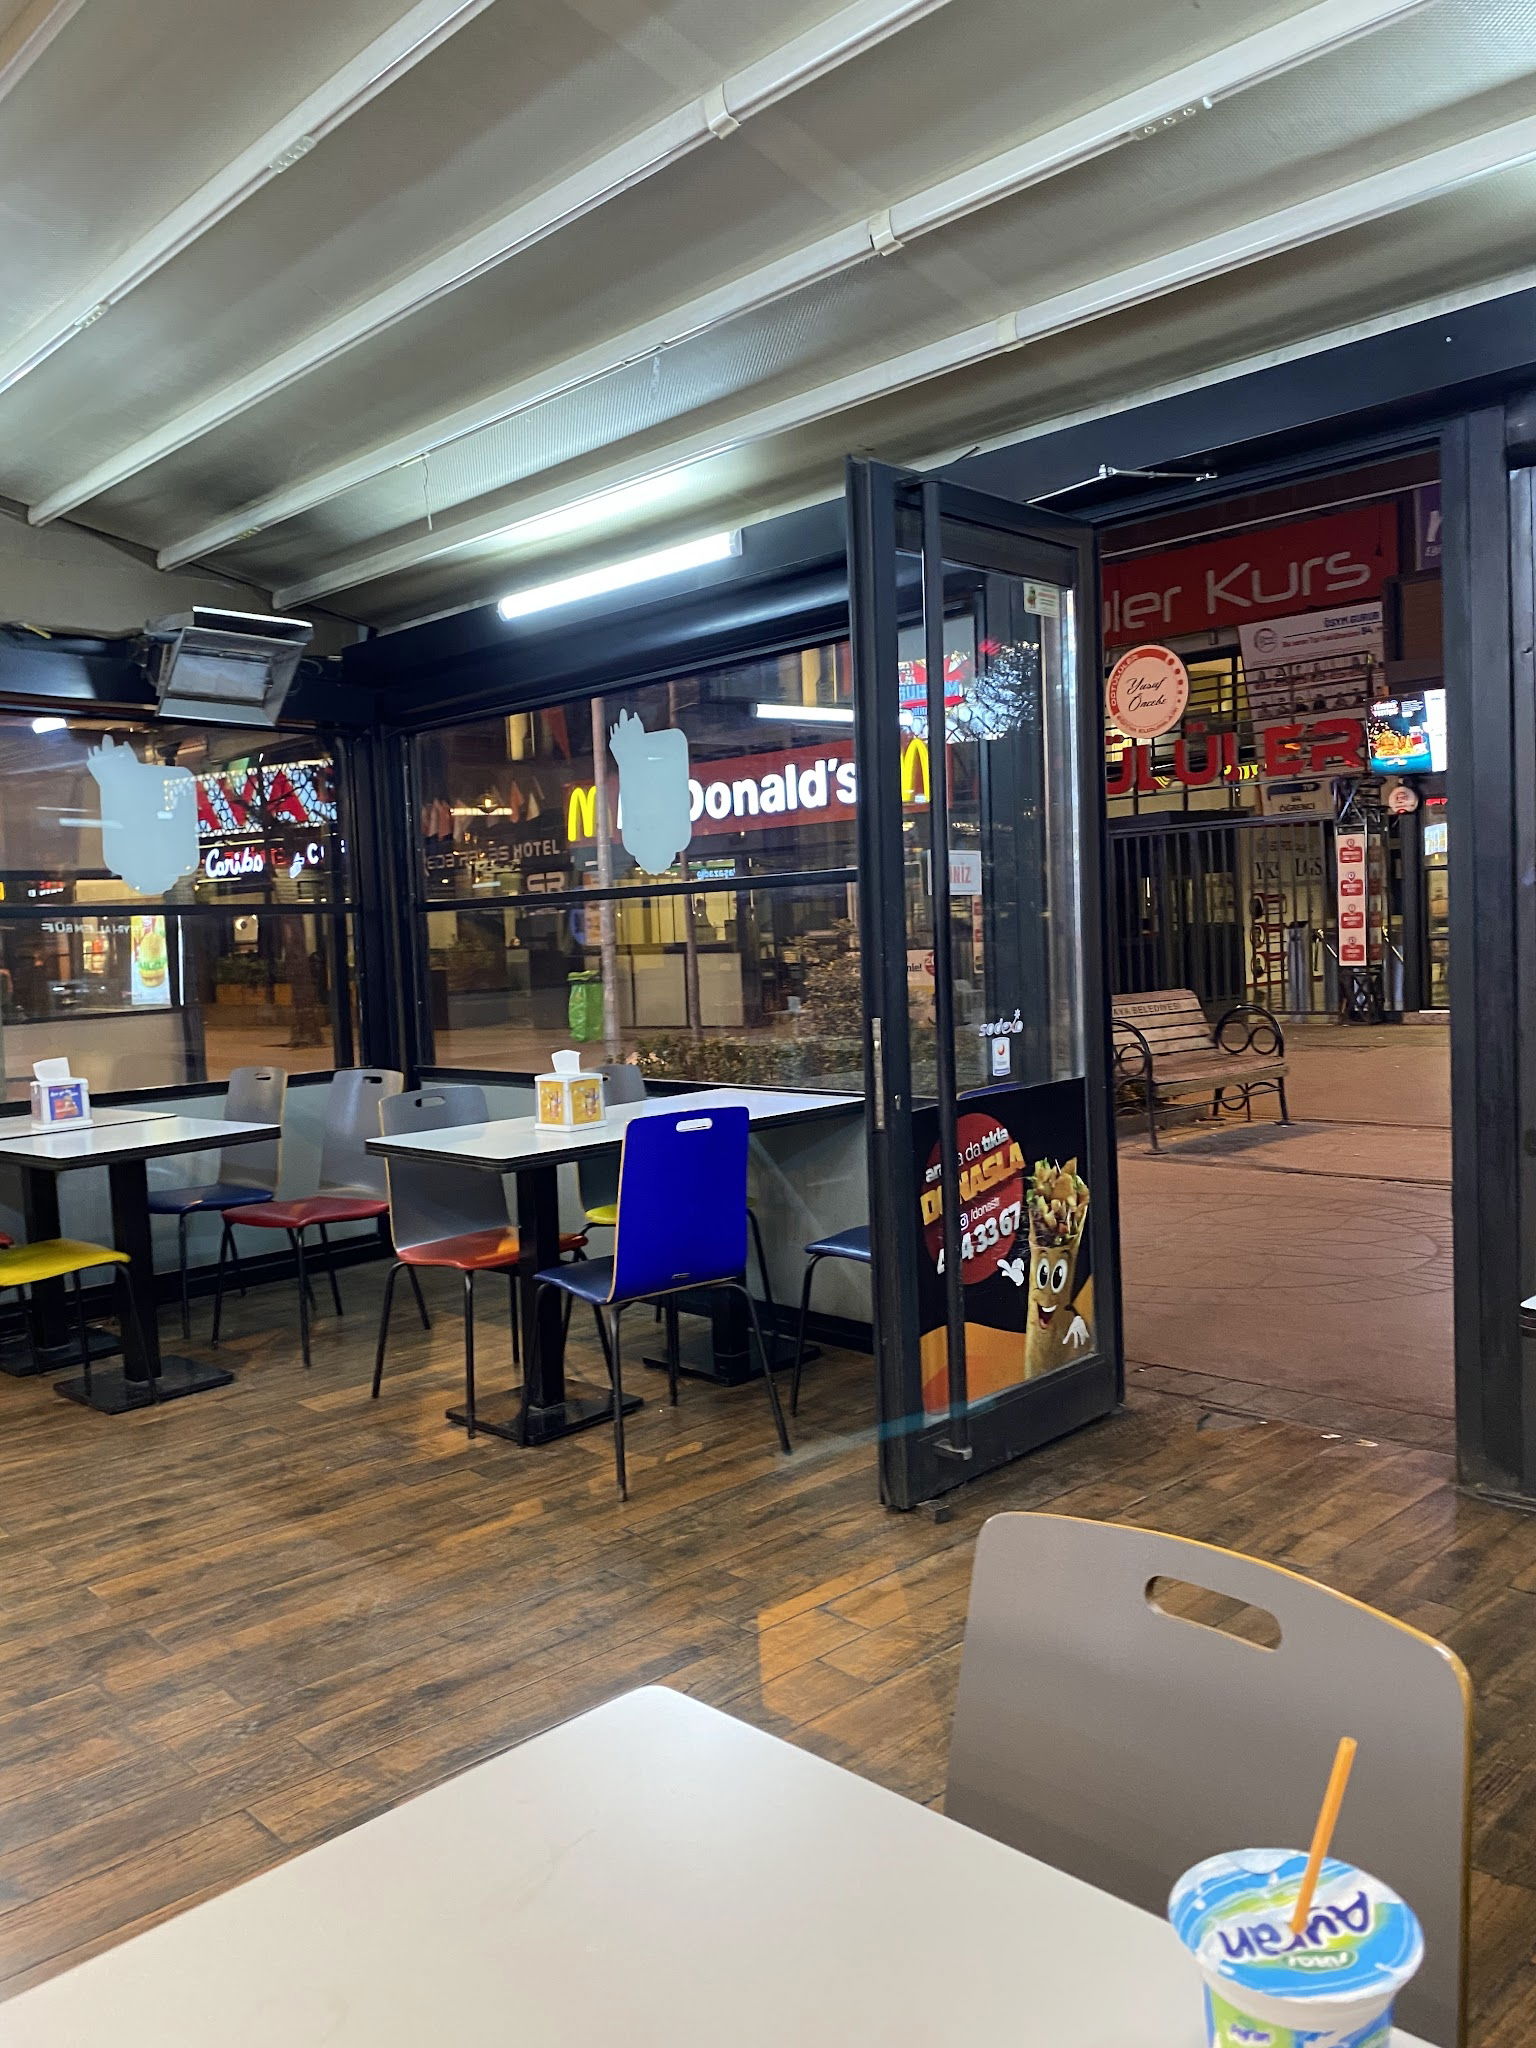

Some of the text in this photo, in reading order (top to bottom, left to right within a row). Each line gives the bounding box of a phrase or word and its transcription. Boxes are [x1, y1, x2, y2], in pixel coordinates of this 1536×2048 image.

[1104, 550, 1371, 635] ler Kurs
[1127, 677, 1168, 695] Yusuf
[205, 847, 263, 878] Caribo
[513, 839, 561, 859] HOTEL
[979, 1010, 1024, 1037] sodexo
[925, 1163, 942, 1183] ar
[966, 1142, 981, 1161] da
[920, 1141, 1027, 1226] DNASLA
[999, 1201, 1022, 1236] 67
